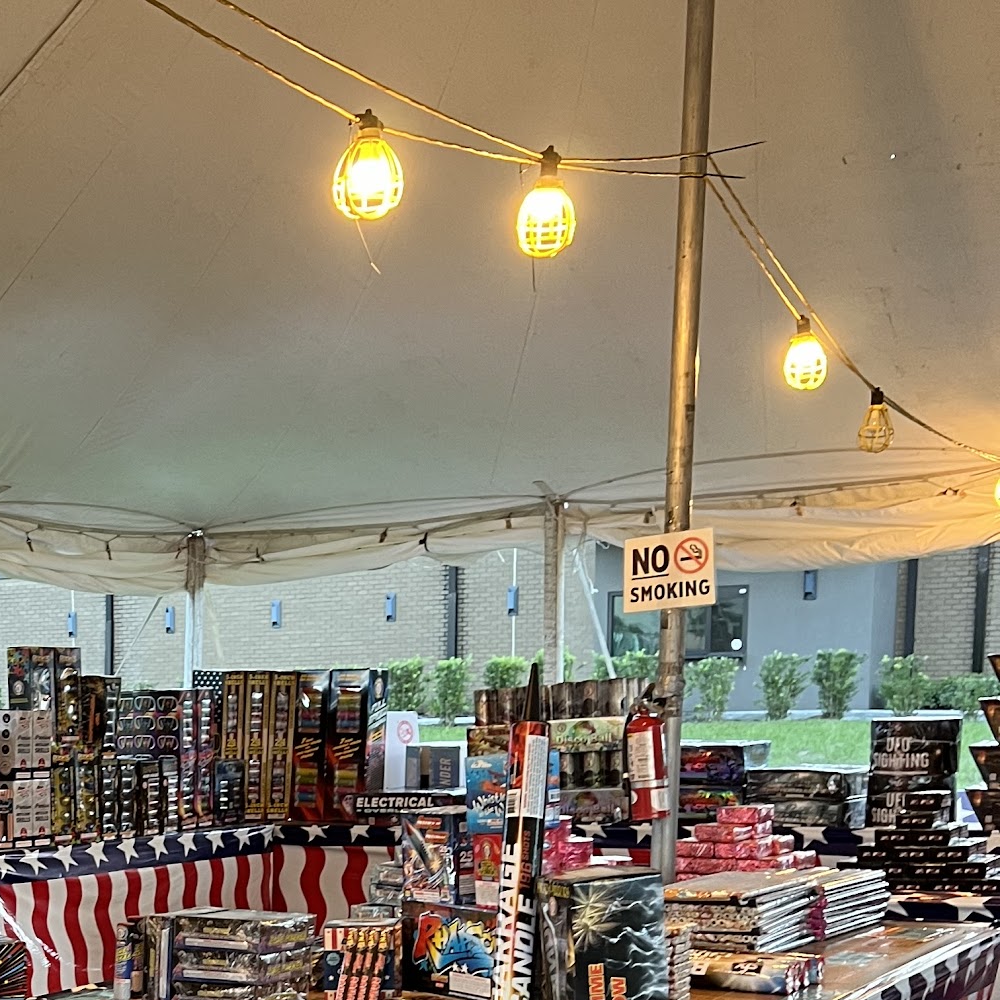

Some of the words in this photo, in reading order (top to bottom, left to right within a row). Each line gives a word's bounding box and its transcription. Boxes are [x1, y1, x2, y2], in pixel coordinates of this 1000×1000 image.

[631, 544, 670, 576] NO
[630, 579, 710, 603] SMOKING
[886, 736, 912, 753] UFO
[872, 751, 930, 769] SIGHTING
[439, 758, 452, 786] NDER
[356, 797, 434, 808] ELECTRICAL
[886, 792, 906, 808] UF
[871, 808, 897, 824] SIGH
[522, 830, 531, 860] SHOTS
[460, 850, 473, 862] 25
[519, 861, 532, 889] 196
